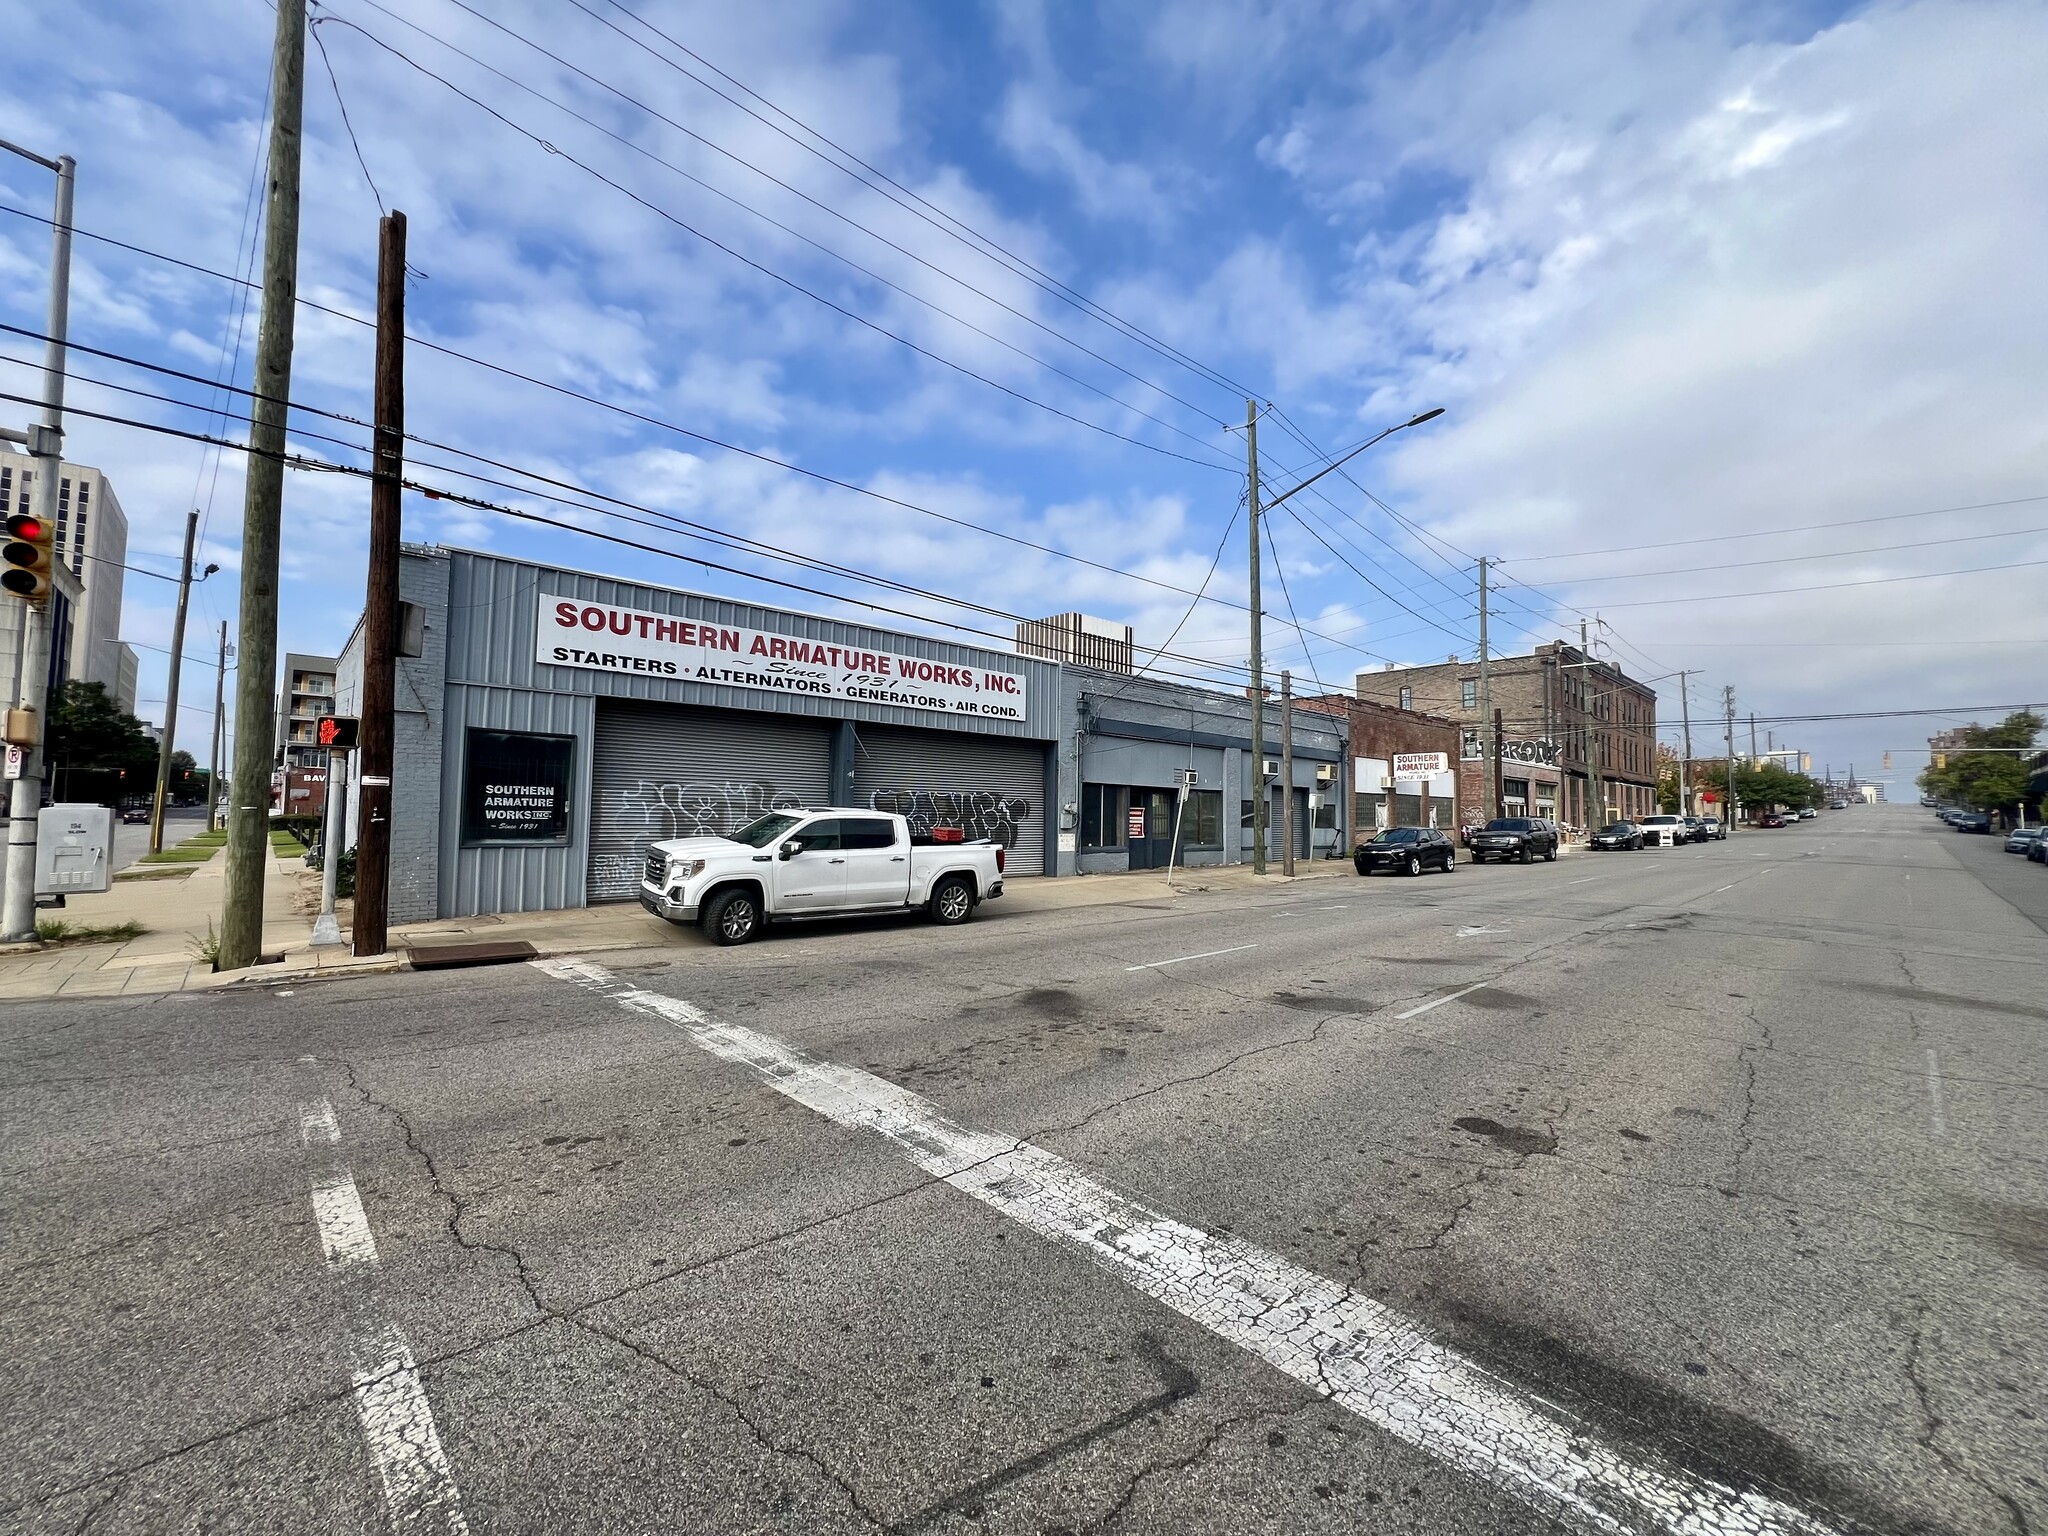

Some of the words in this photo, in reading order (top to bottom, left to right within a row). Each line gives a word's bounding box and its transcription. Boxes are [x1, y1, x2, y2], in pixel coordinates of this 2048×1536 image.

[555, 602, 740, 653] SOUTHERN
[749, 635, 891, 676] ARMATURE
[898, 659, 980, 693] WORKS,
[984, 673, 1021, 695] INC.
[764, 662, 827, 680] Since
[842, 673, 899, 689] 1931
[553, 647, 677, 674] STARTERS
[696, 666, 831, 694] ALTERNATORS
[846, 687, 947, 709] GENERATORS
[956, 701, 978, 713] AIR
[981, 704, 1020, 718] COND.
[1397, 754, 1439, 763] SOUTHERN
[1396, 762, 1440, 771] ARMATURE
[485, 785, 554, 796] SOUTHERN
[484, 797, 554, 807] ARMATURE
[485, 810, 532, 820] WORKS
